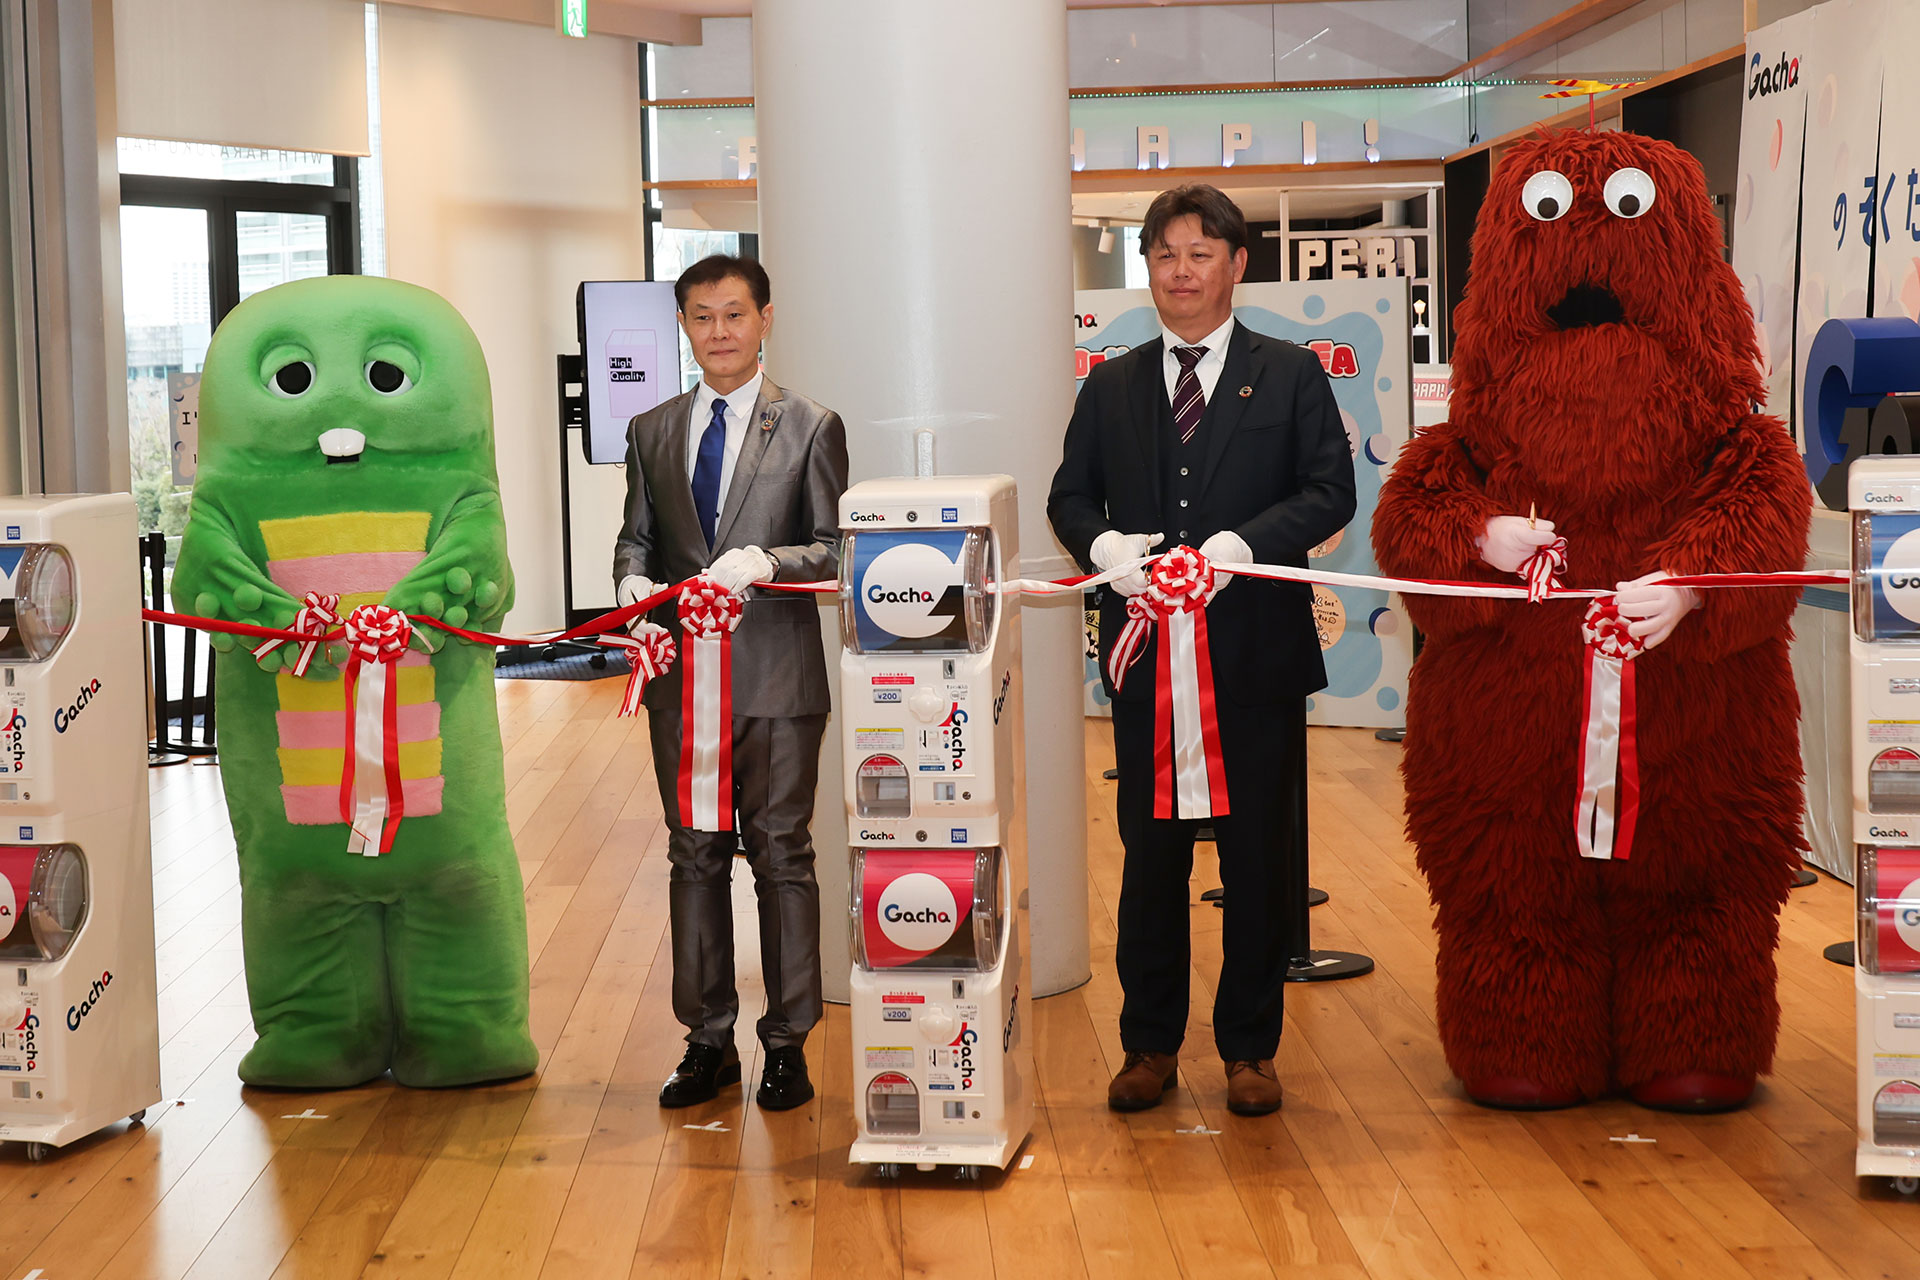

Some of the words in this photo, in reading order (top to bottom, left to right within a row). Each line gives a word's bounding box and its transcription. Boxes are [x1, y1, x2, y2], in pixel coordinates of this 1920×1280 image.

[1748, 51, 1800, 101] Gacha
[1298, 237, 1416, 281] PERI
[609, 357, 632, 368] High
[610, 372, 645, 382] Quality
[1864, 492, 1904, 503] Gacha
[850, 511, 886, 522] Gacha
[867, 584, 935, 604] Gacha
[54, 677, 102, 734] Gacha
[877, 692, 898, 700] ¥200
[993, 670, 1011, 726] Gacha
[13, 715, 27, 773] Gacha
[951, 709, 969, 772] Gacha
[860, 830, 895, 840] Gacha
[1869, 826, 1909, 838] Gacha
[884, 904, 951, 924] Gacha
[66, 970, 113, 1032] Gacha
[887, 1010, 907, 1018] ¥200
[1003, 984, 1019, 1054] Gacha
[26, 1014, 40, 1072] Gacha
[961, 1029, 978, 1091] Gacha
